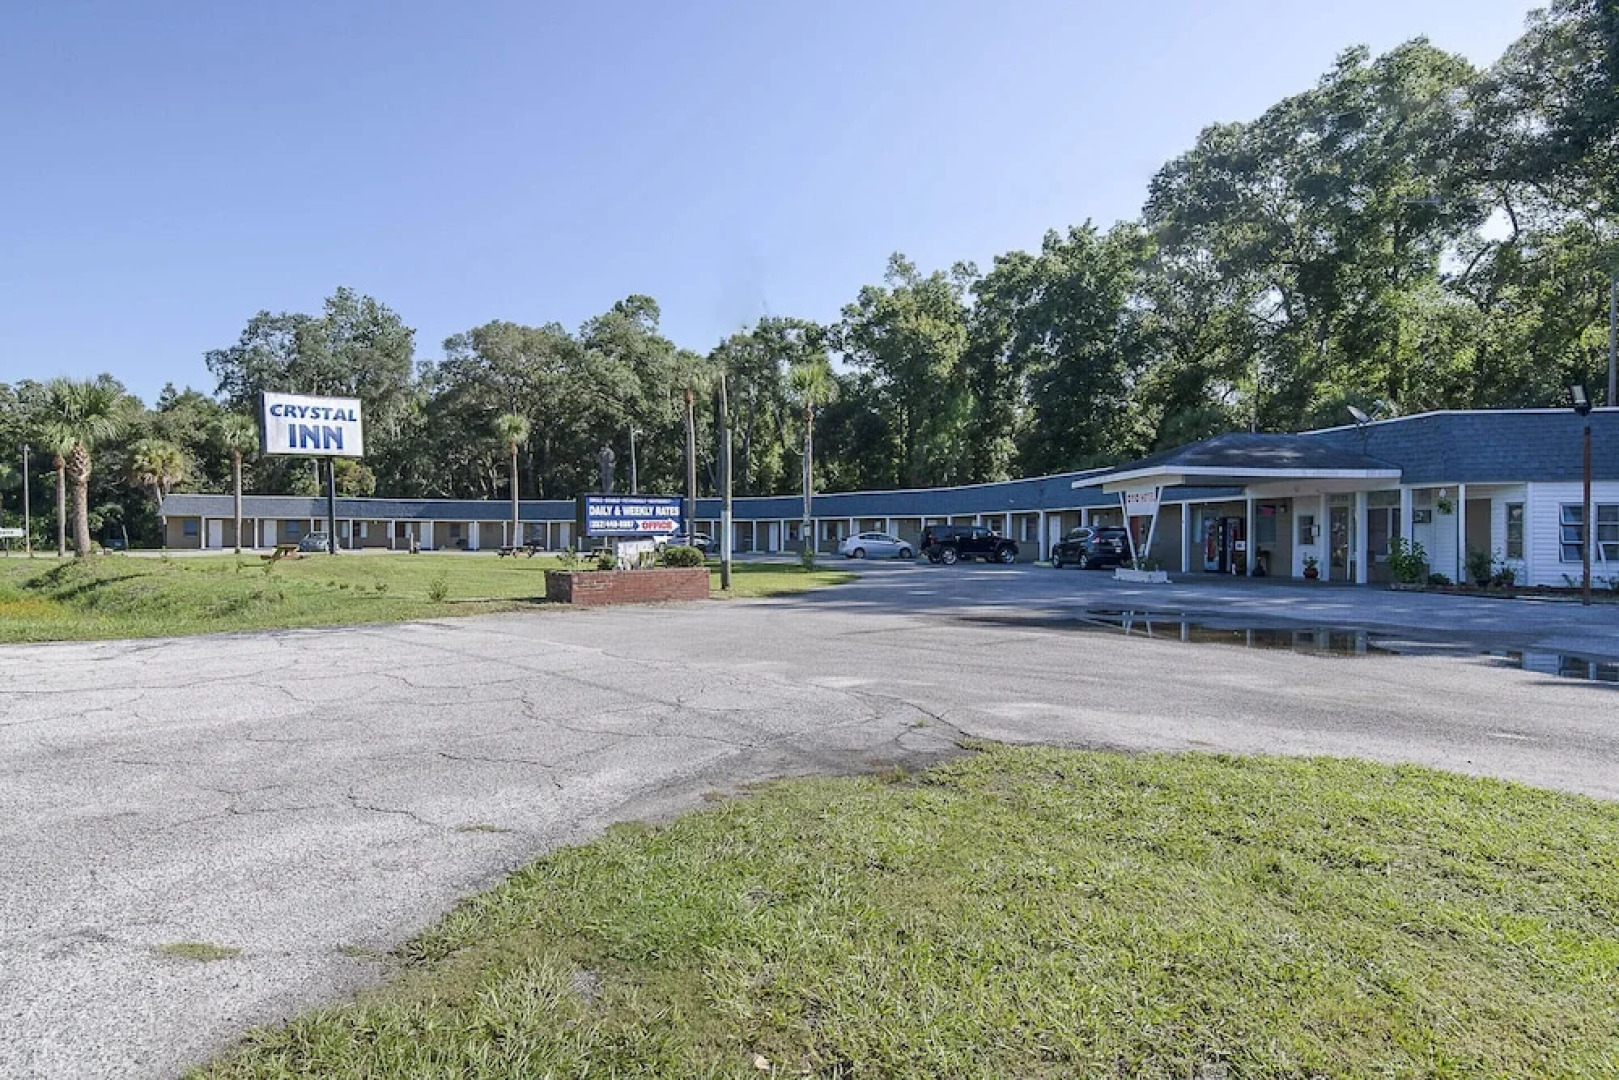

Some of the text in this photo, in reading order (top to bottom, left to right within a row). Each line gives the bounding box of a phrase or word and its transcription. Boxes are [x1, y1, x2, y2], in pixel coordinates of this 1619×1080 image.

[270, 403, 357, 422] CRYSTAL
[288, 423, 344, 450] INN
[589, 504, 680, 516] DAILY & WEEKLY RATES
[641, 521, 672, 530] OFFICE
